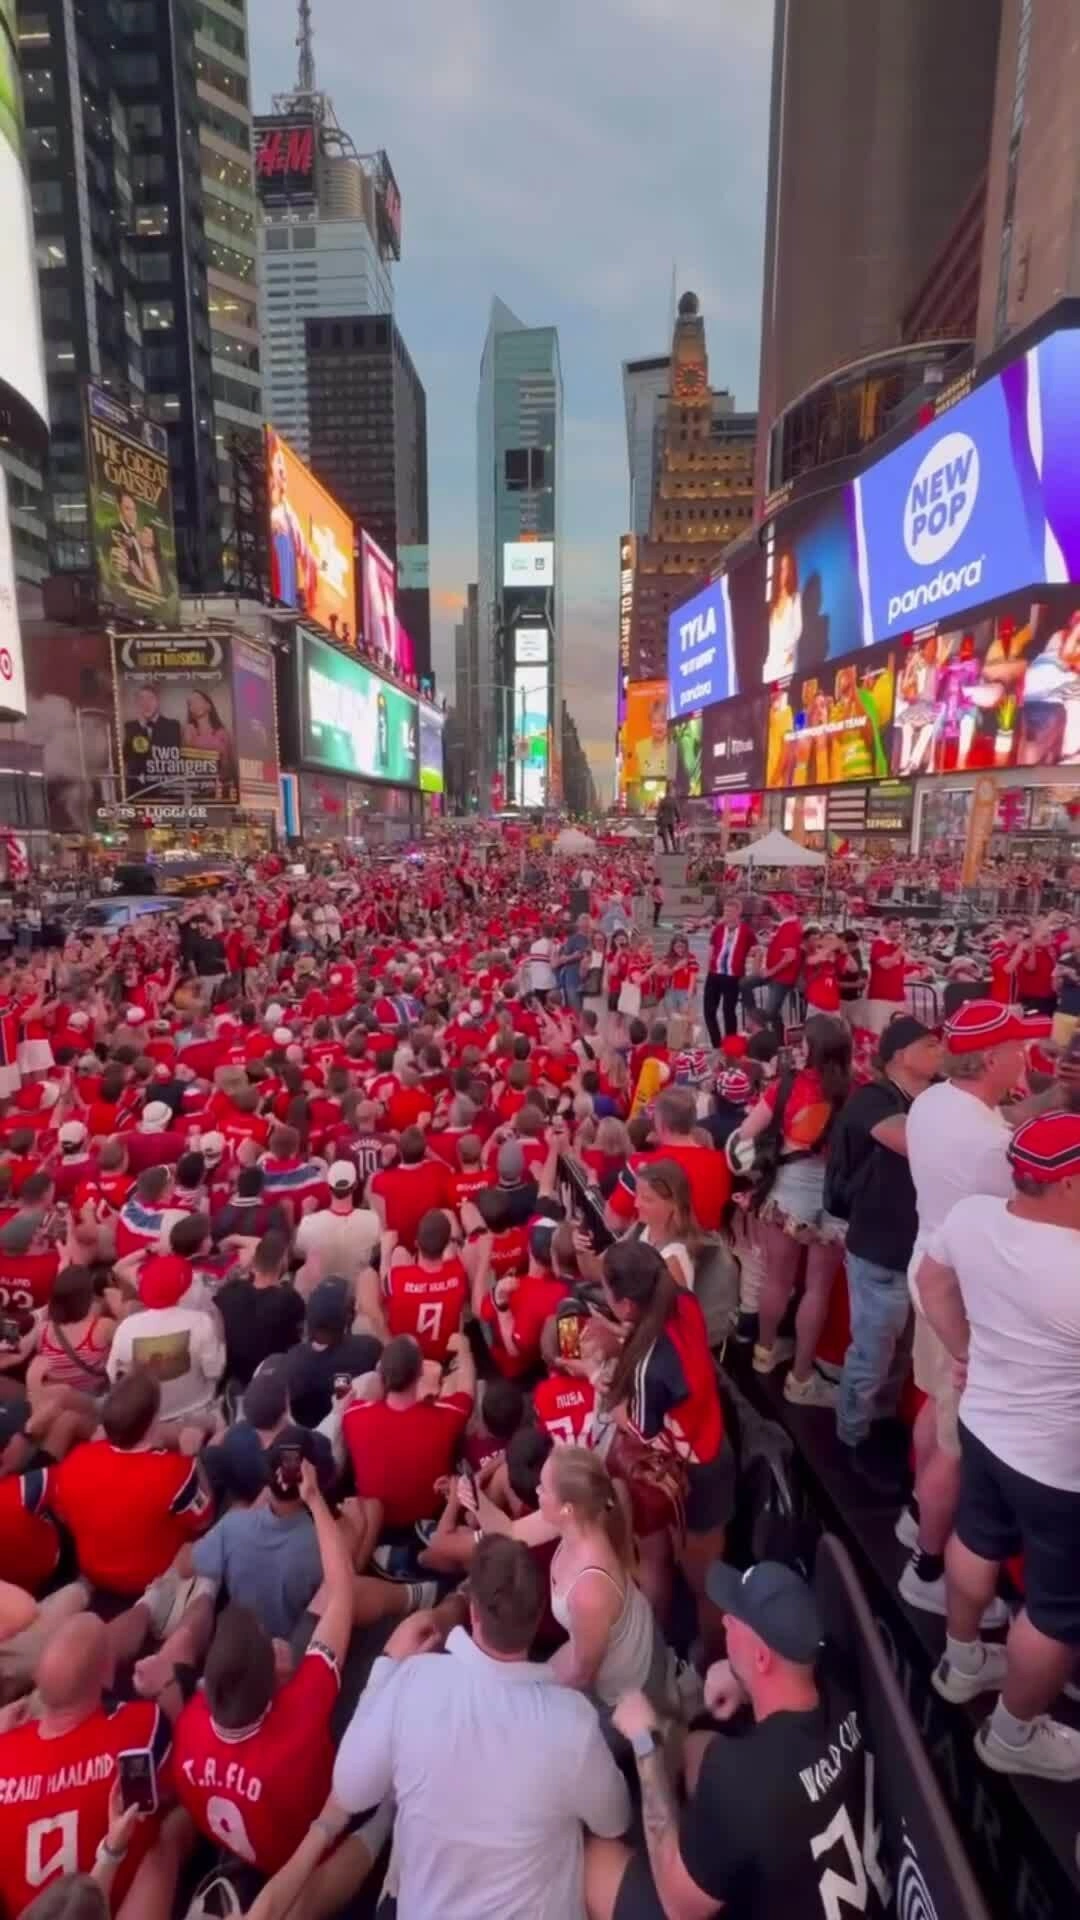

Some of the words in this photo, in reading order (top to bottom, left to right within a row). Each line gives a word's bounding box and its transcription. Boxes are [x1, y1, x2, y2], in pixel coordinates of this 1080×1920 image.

[92, 426, 123, 464] THE
[122, 447, 168, 489] GREAT
[104, 460, 162, 504] GATSBY
[911, 448, 975, 514] NEW
[911, 491, 967, 546] POP
[888, 559, 984, 625] pandora
[680, 607, 717, 652] TYLA
[145, 760, 217, 778] strangers
[151, 745, 180, 761] two
[97, 807, 137, 818] GTS
[416, 1301, 444, 1342] 9
[47, 1752, 115, 1794] HAALAND
[26, 1809, 79, 1888] 9
